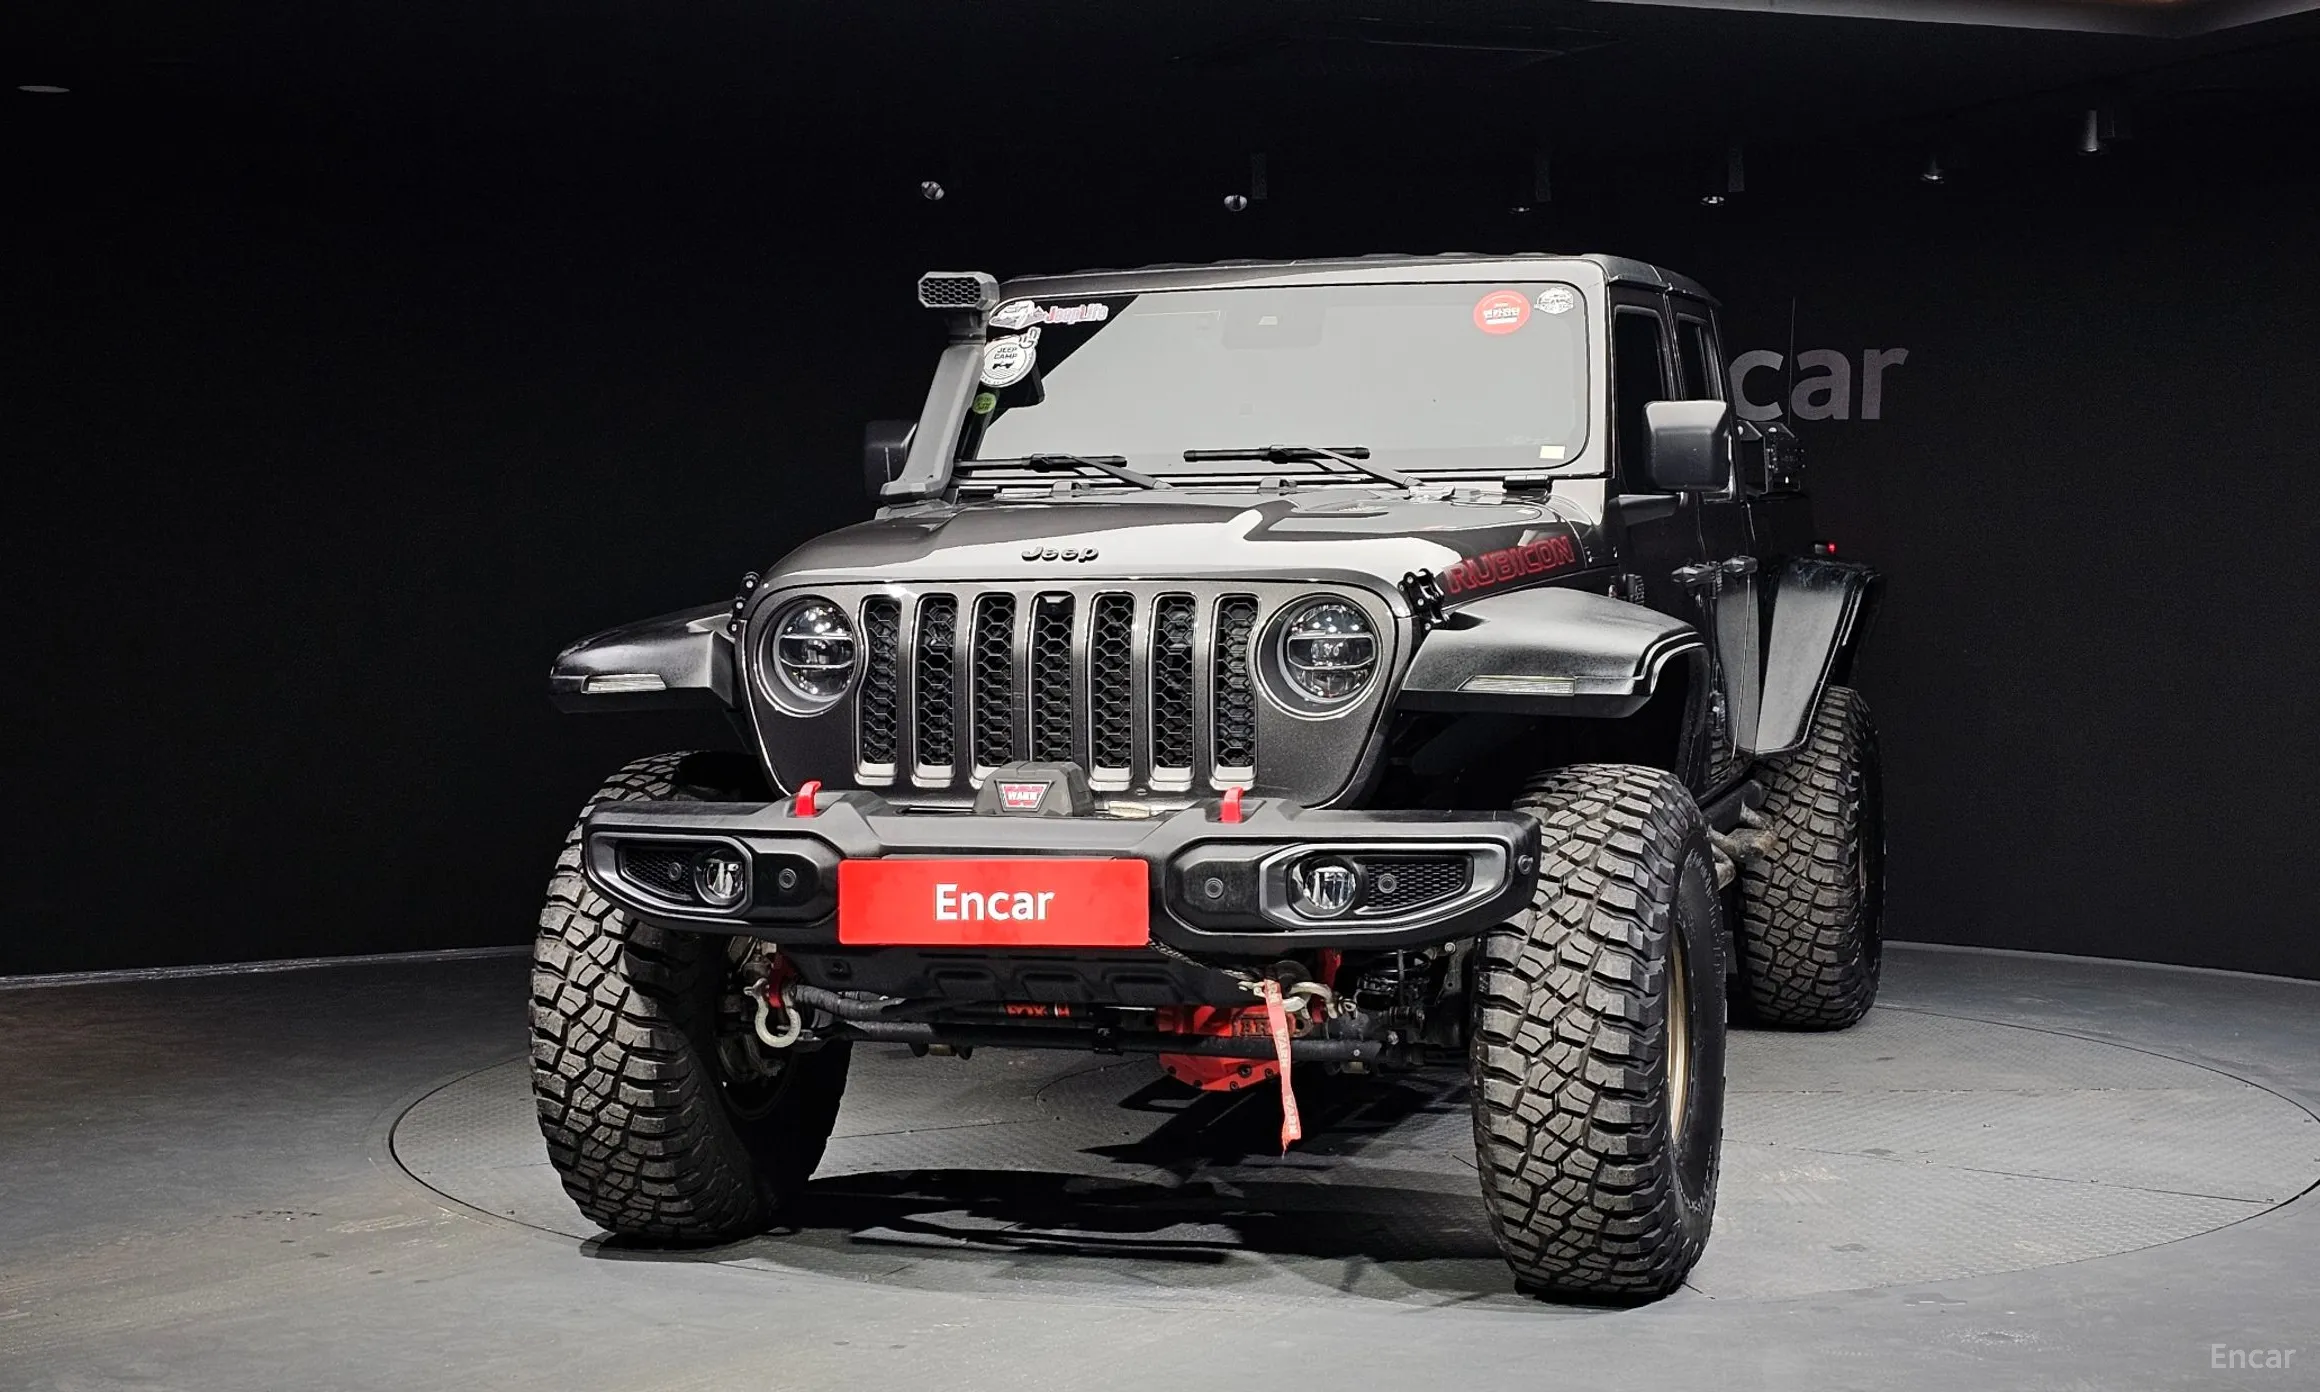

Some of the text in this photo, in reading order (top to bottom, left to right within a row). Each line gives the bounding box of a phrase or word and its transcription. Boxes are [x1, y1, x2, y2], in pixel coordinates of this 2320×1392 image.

[1729, 347, 1910, 422] car
[1021, 546, 1099, 563] Jeep
[1446, 535, 1576, 594] RUBICON
[1006, 791, 1040, 801] WARN
[935, 883, 1056, 921] Encar
